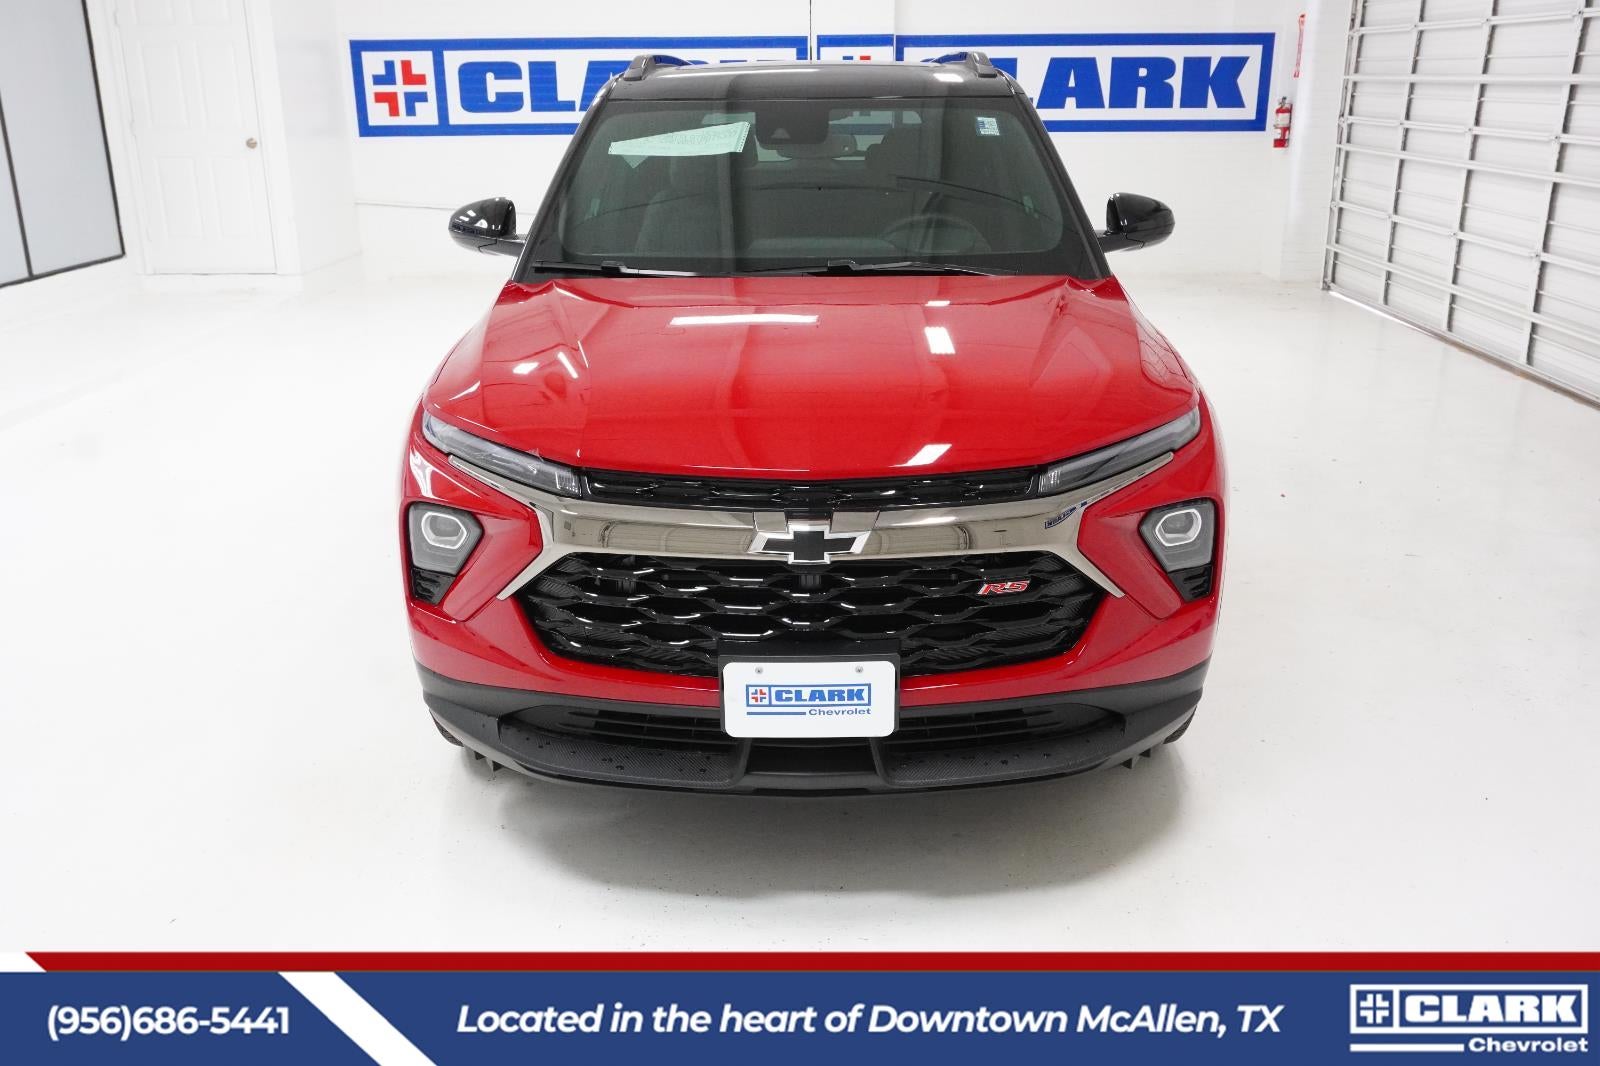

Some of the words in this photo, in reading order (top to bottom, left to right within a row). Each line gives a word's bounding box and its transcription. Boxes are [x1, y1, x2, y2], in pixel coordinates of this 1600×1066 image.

[985, 55, 1250, 109] ARK
[977, 580, 1030, 595] RS
[774, 688, 866, 702] CLARK
[808, 707, 872, 716] Chevrolet
